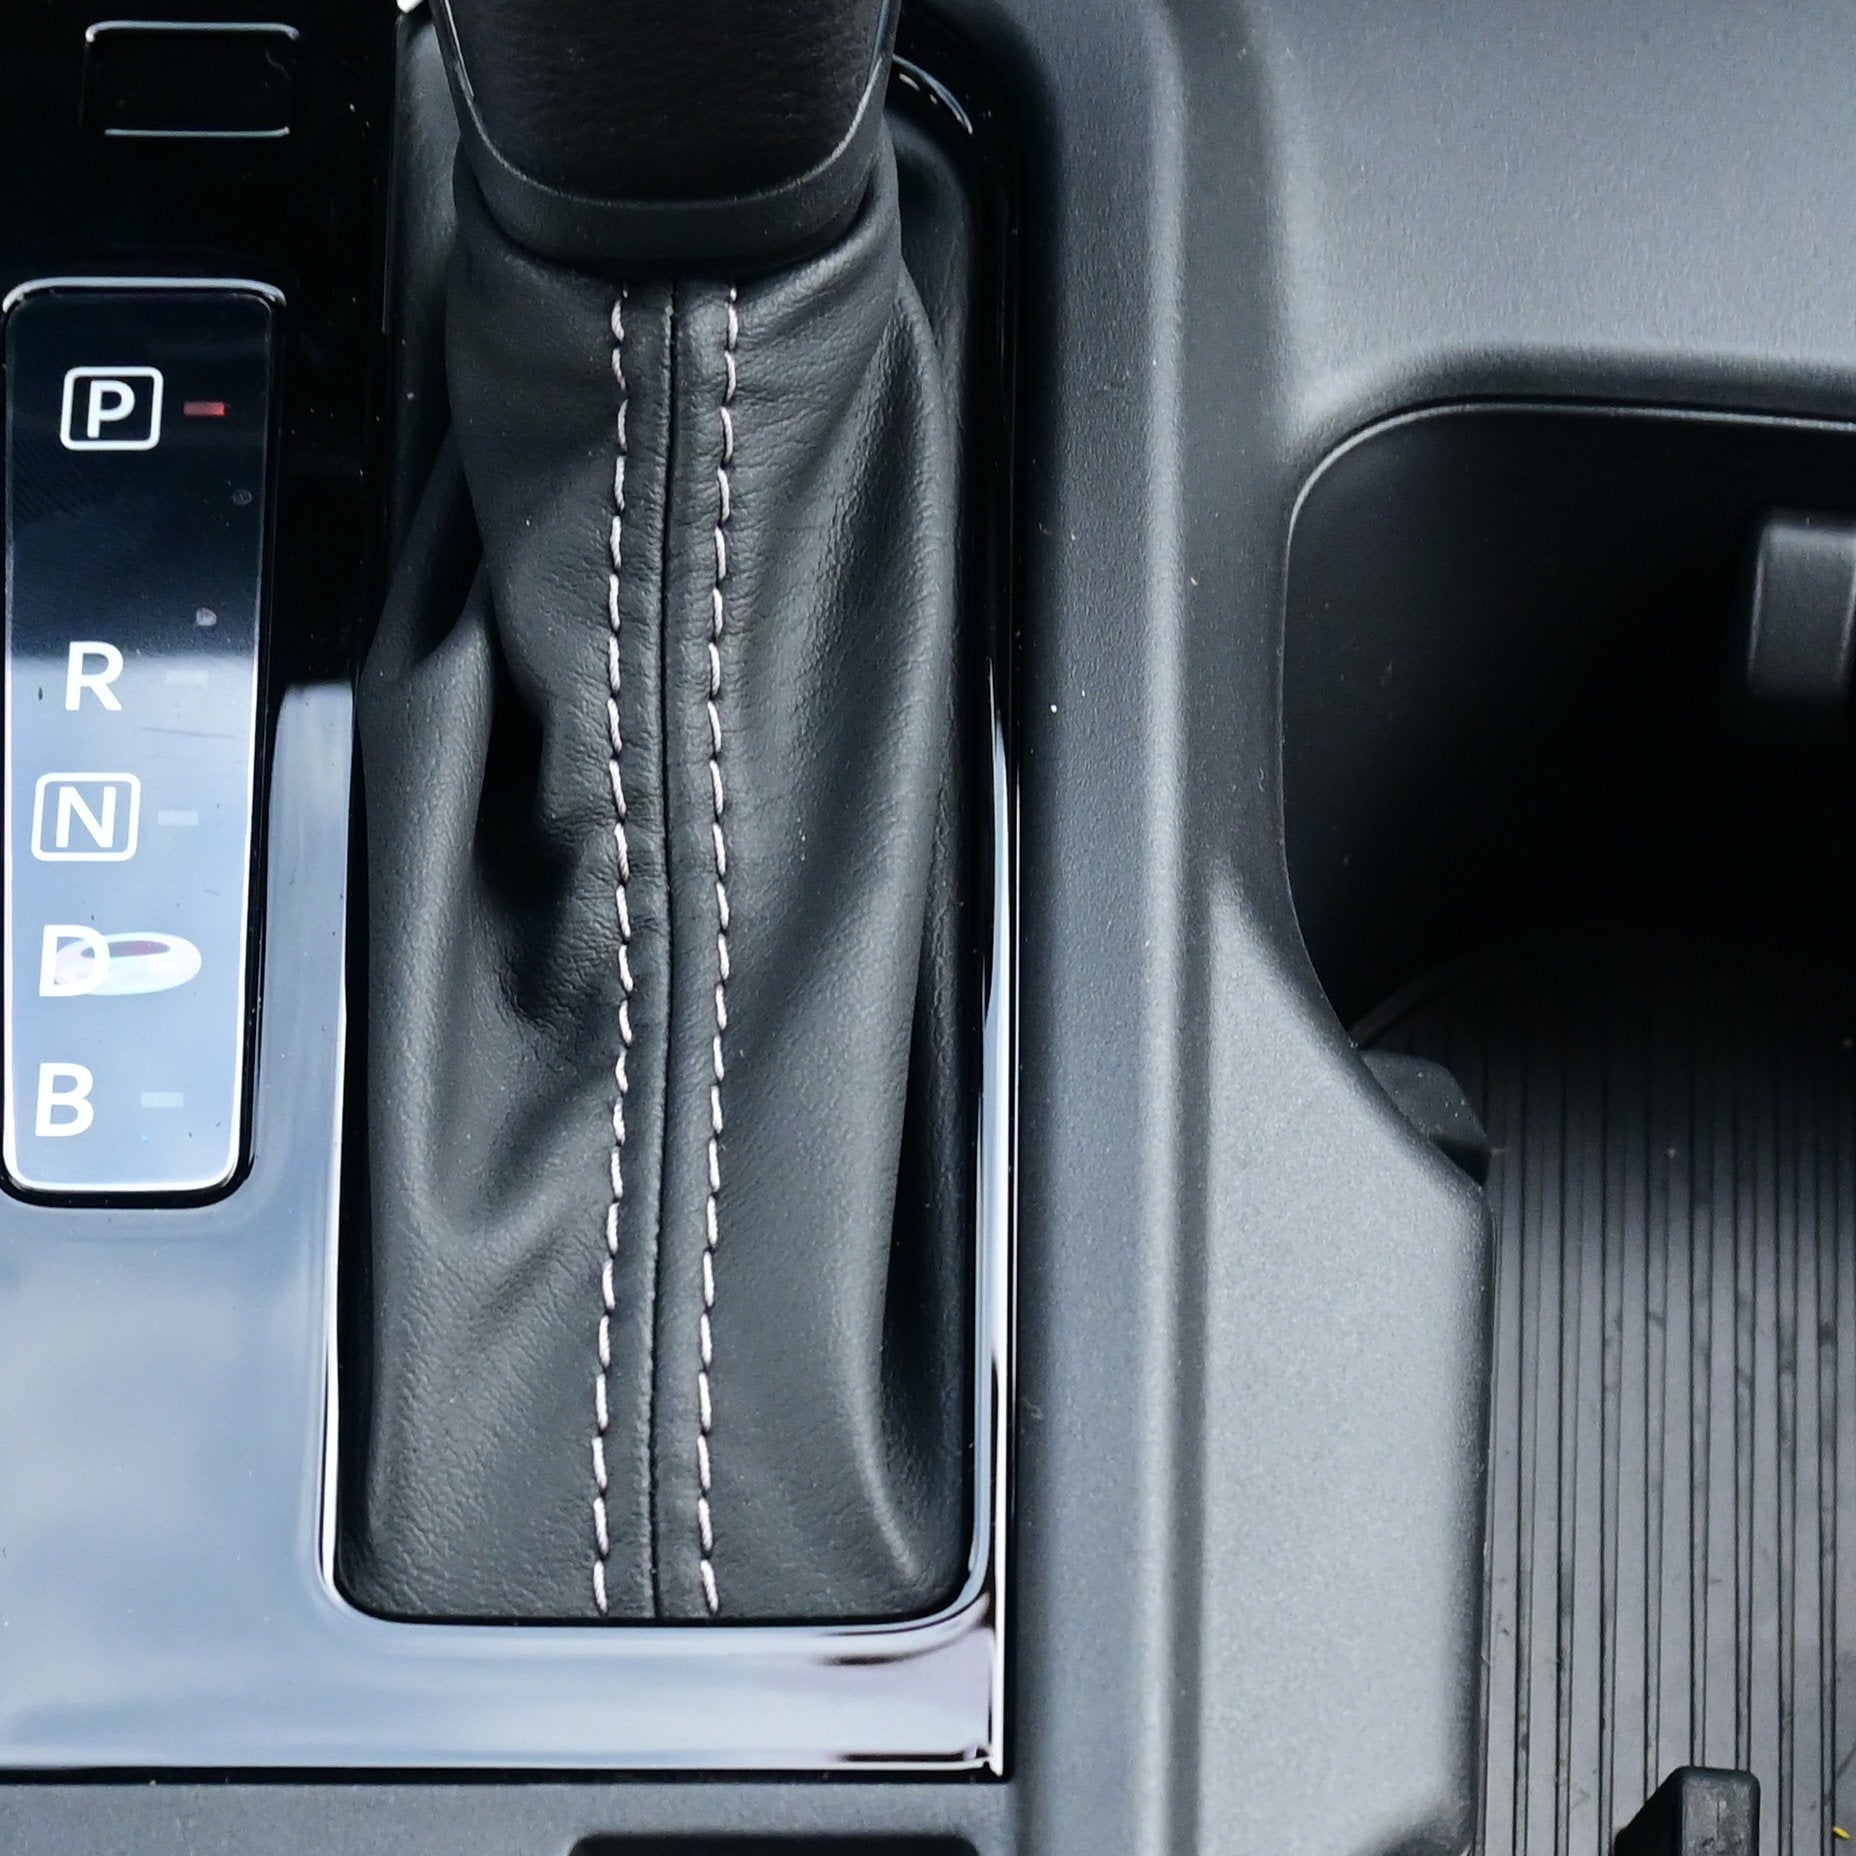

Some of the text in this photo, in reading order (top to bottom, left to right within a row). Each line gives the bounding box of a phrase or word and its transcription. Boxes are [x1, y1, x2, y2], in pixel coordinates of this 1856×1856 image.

[87, 380, 136, 439] P
[64, 641, 124, 711] R
[55, 786, 117, 848] N
[39, 924, 110, 997] D
[34, 1062, 95, 1138] B
